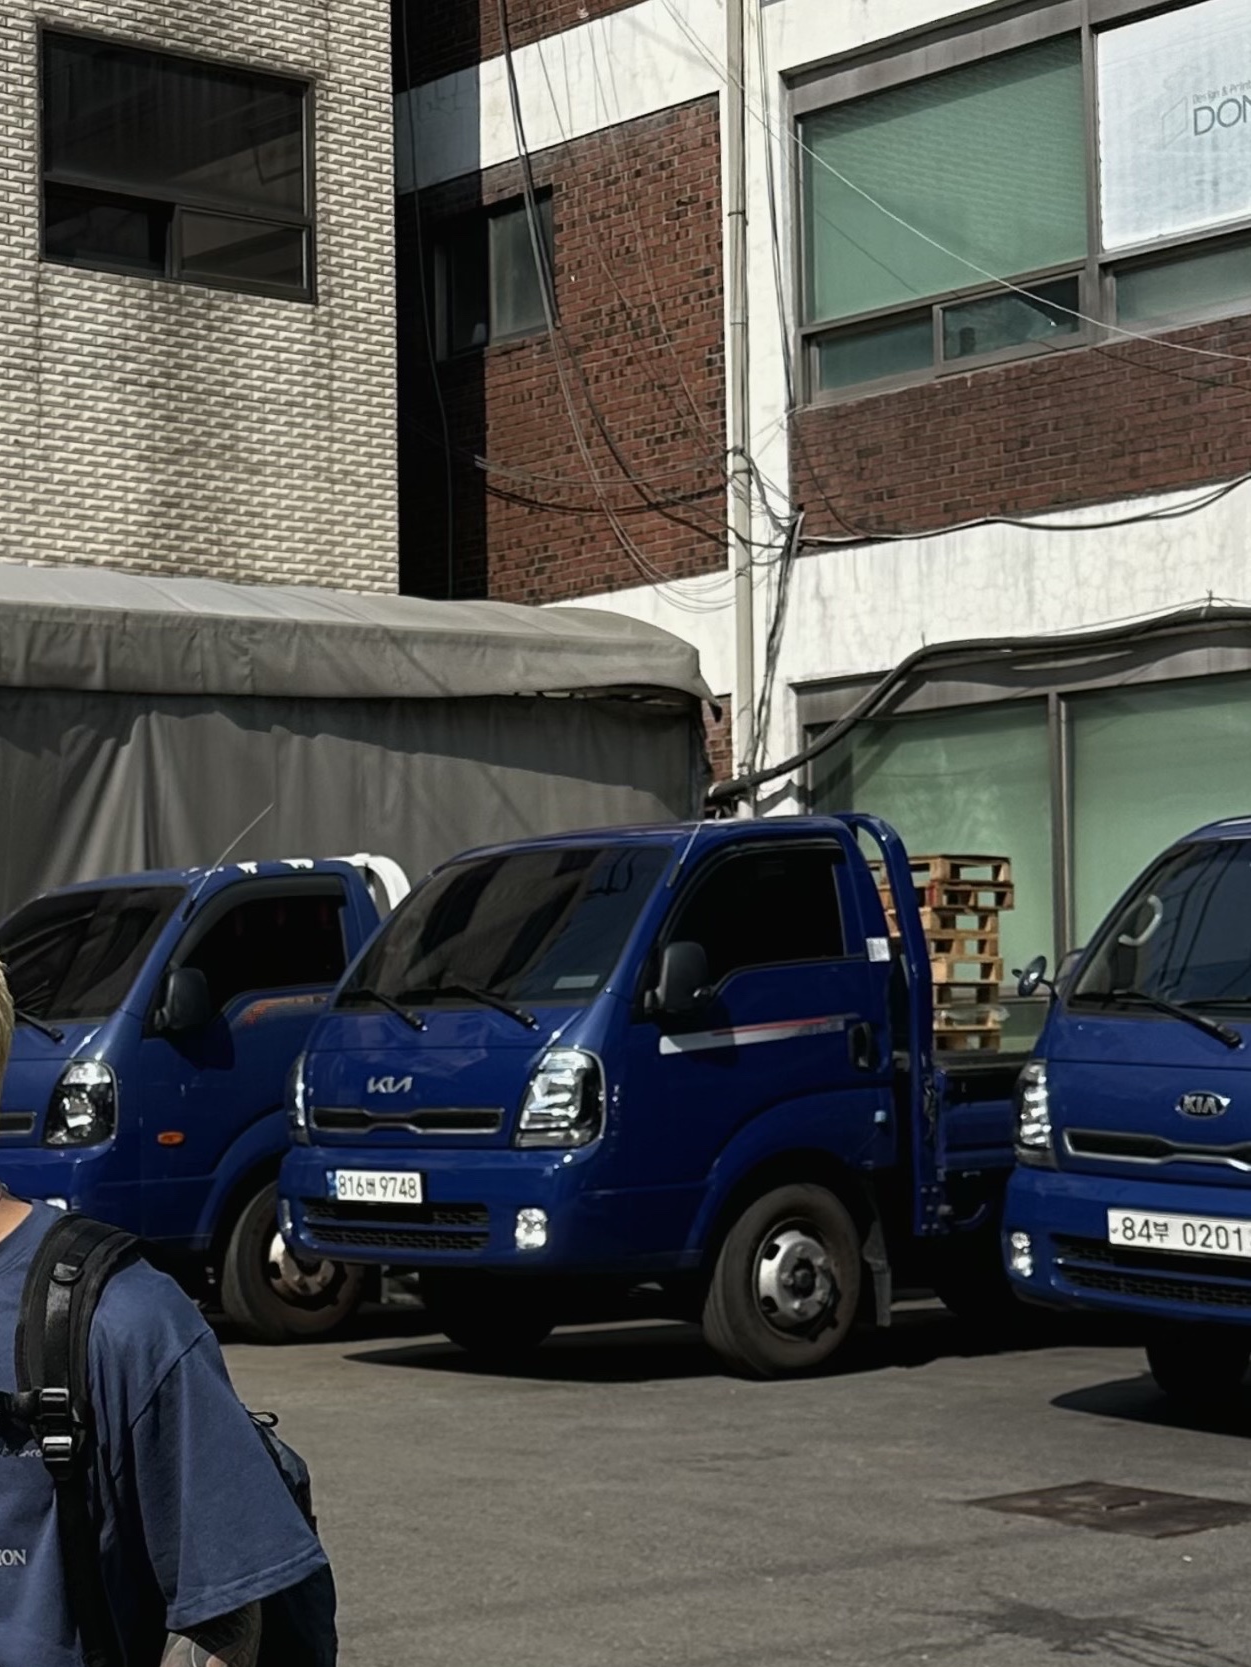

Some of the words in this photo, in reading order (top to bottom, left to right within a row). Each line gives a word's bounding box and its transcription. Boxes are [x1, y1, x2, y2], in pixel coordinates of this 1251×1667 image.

[367, 1076, 413, 1093] KIA
[1182, 1095, 1219, 1114] KIA
[379, 1176, 417, 1199] 9748
[1121, 1216, 1169, 1243] 84부
[1182, 1222, 1243, 1252] 0201
